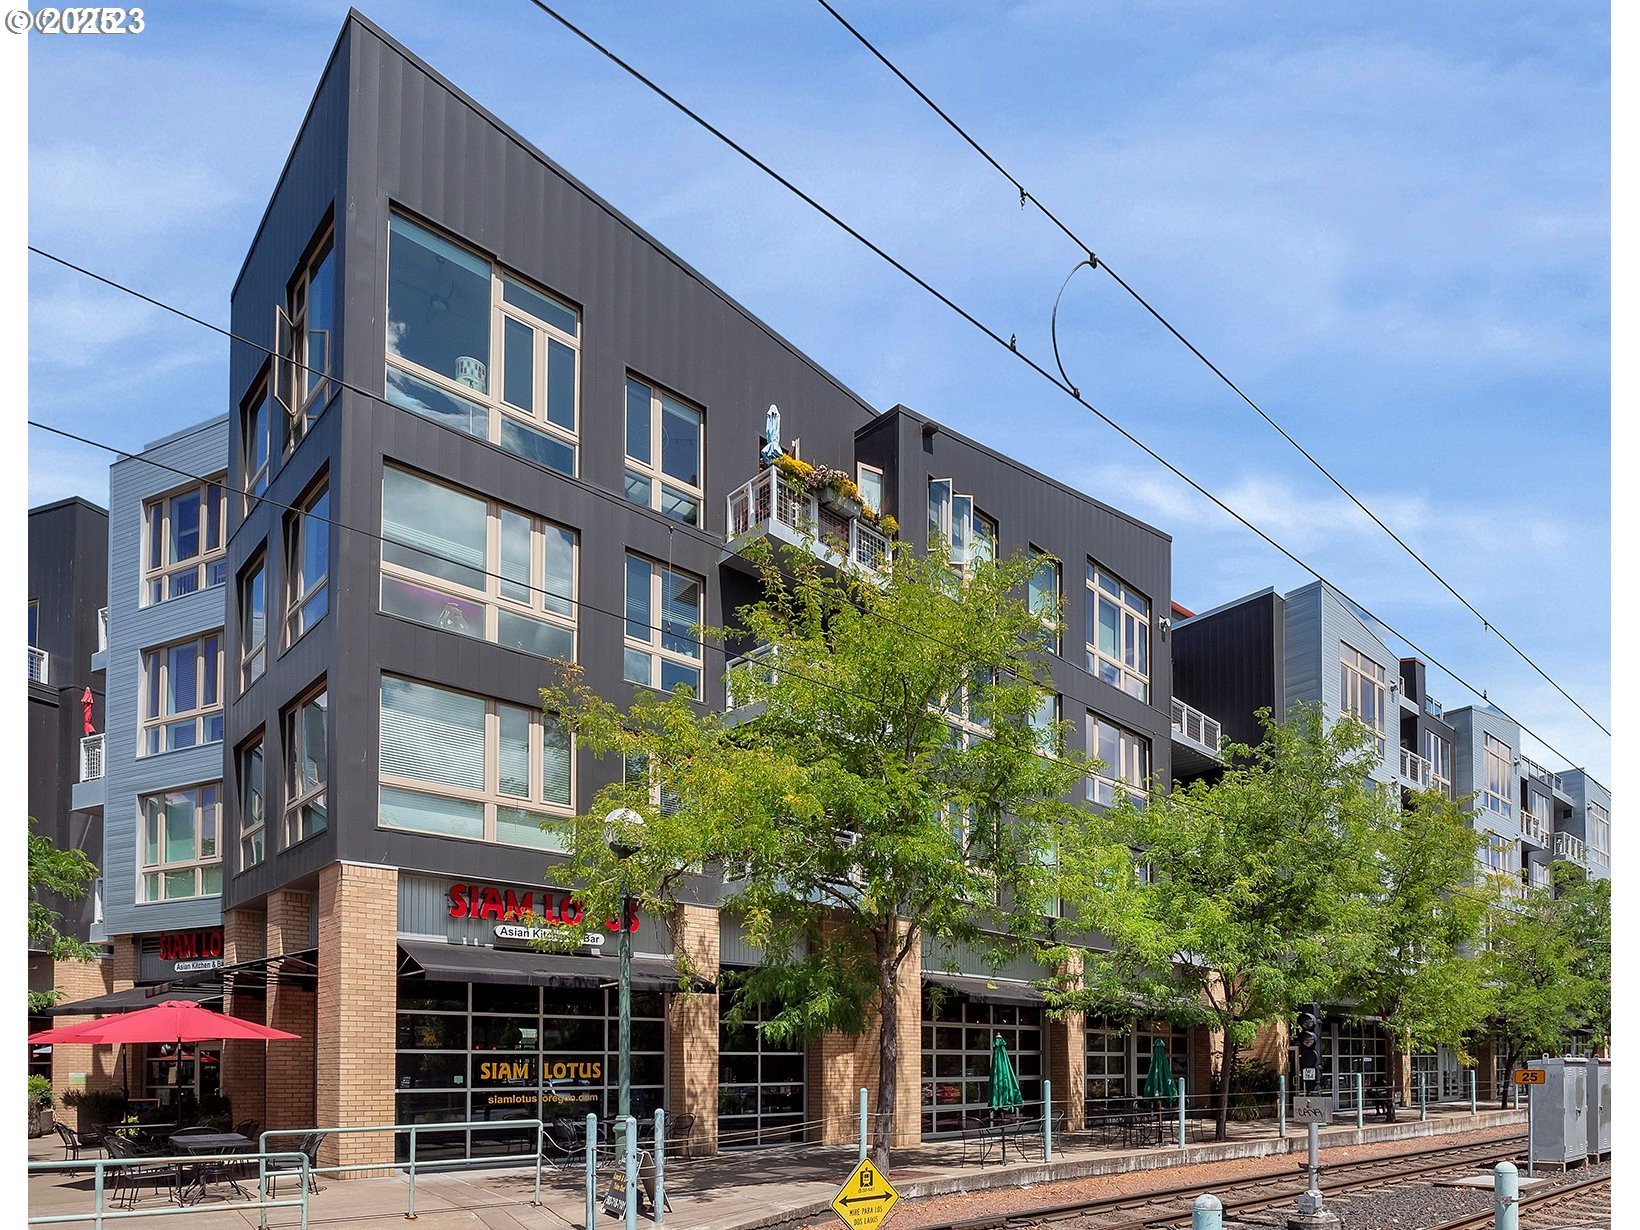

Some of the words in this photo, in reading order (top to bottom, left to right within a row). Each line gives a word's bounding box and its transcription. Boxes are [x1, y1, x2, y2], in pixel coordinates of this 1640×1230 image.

[449, 883, 534, 923] SIAM
[499, 926, 530, 938] Asian
[583, 933, 600, 943] Bar
[159, 932, 198, 960] SIAM
[176, 963, 191, 971] Asian
[192, 962, 211, 970] Kitchen
[212, 960, 216, 968] &
[480, 1062, 529, 1080] SIAM
[543, 1062, 602, 1080] LOTUS
[1521, 1072, 1538, 1082] 25
[849, 1208, 860, 1216] MIRE
[861, 1206, 874, 1215] PARA
[874, 1205, 883, 1213] LOS
[854, 1217, 863, 1226] DOS
[864, 1215, 879, 1225] LADOS
